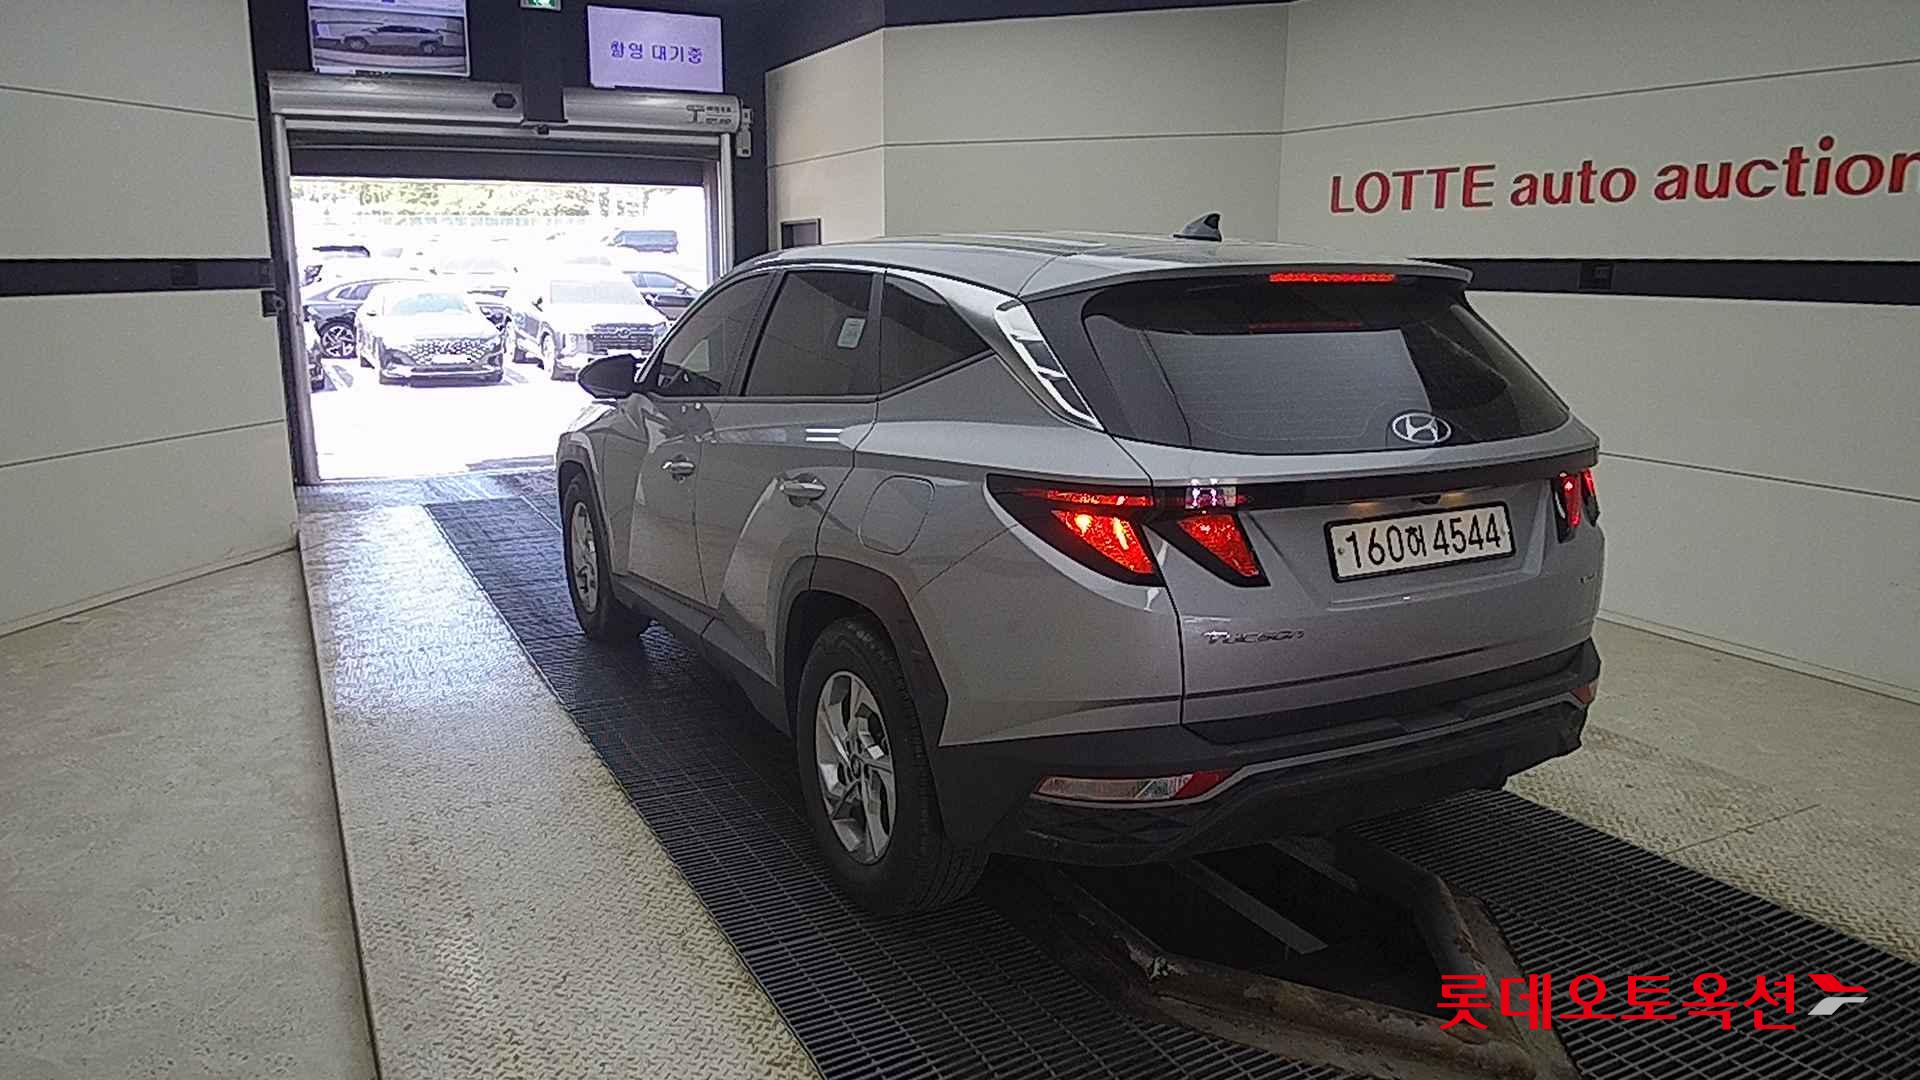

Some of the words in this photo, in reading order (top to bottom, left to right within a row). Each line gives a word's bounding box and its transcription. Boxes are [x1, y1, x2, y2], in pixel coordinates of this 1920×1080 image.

[651, 45, 703, 65] 대기중
[1330, 164, 1496, 213] LOTTE
[1510, 160, 1636, 206] auto
[1654, 135, 1920, 201] auction
